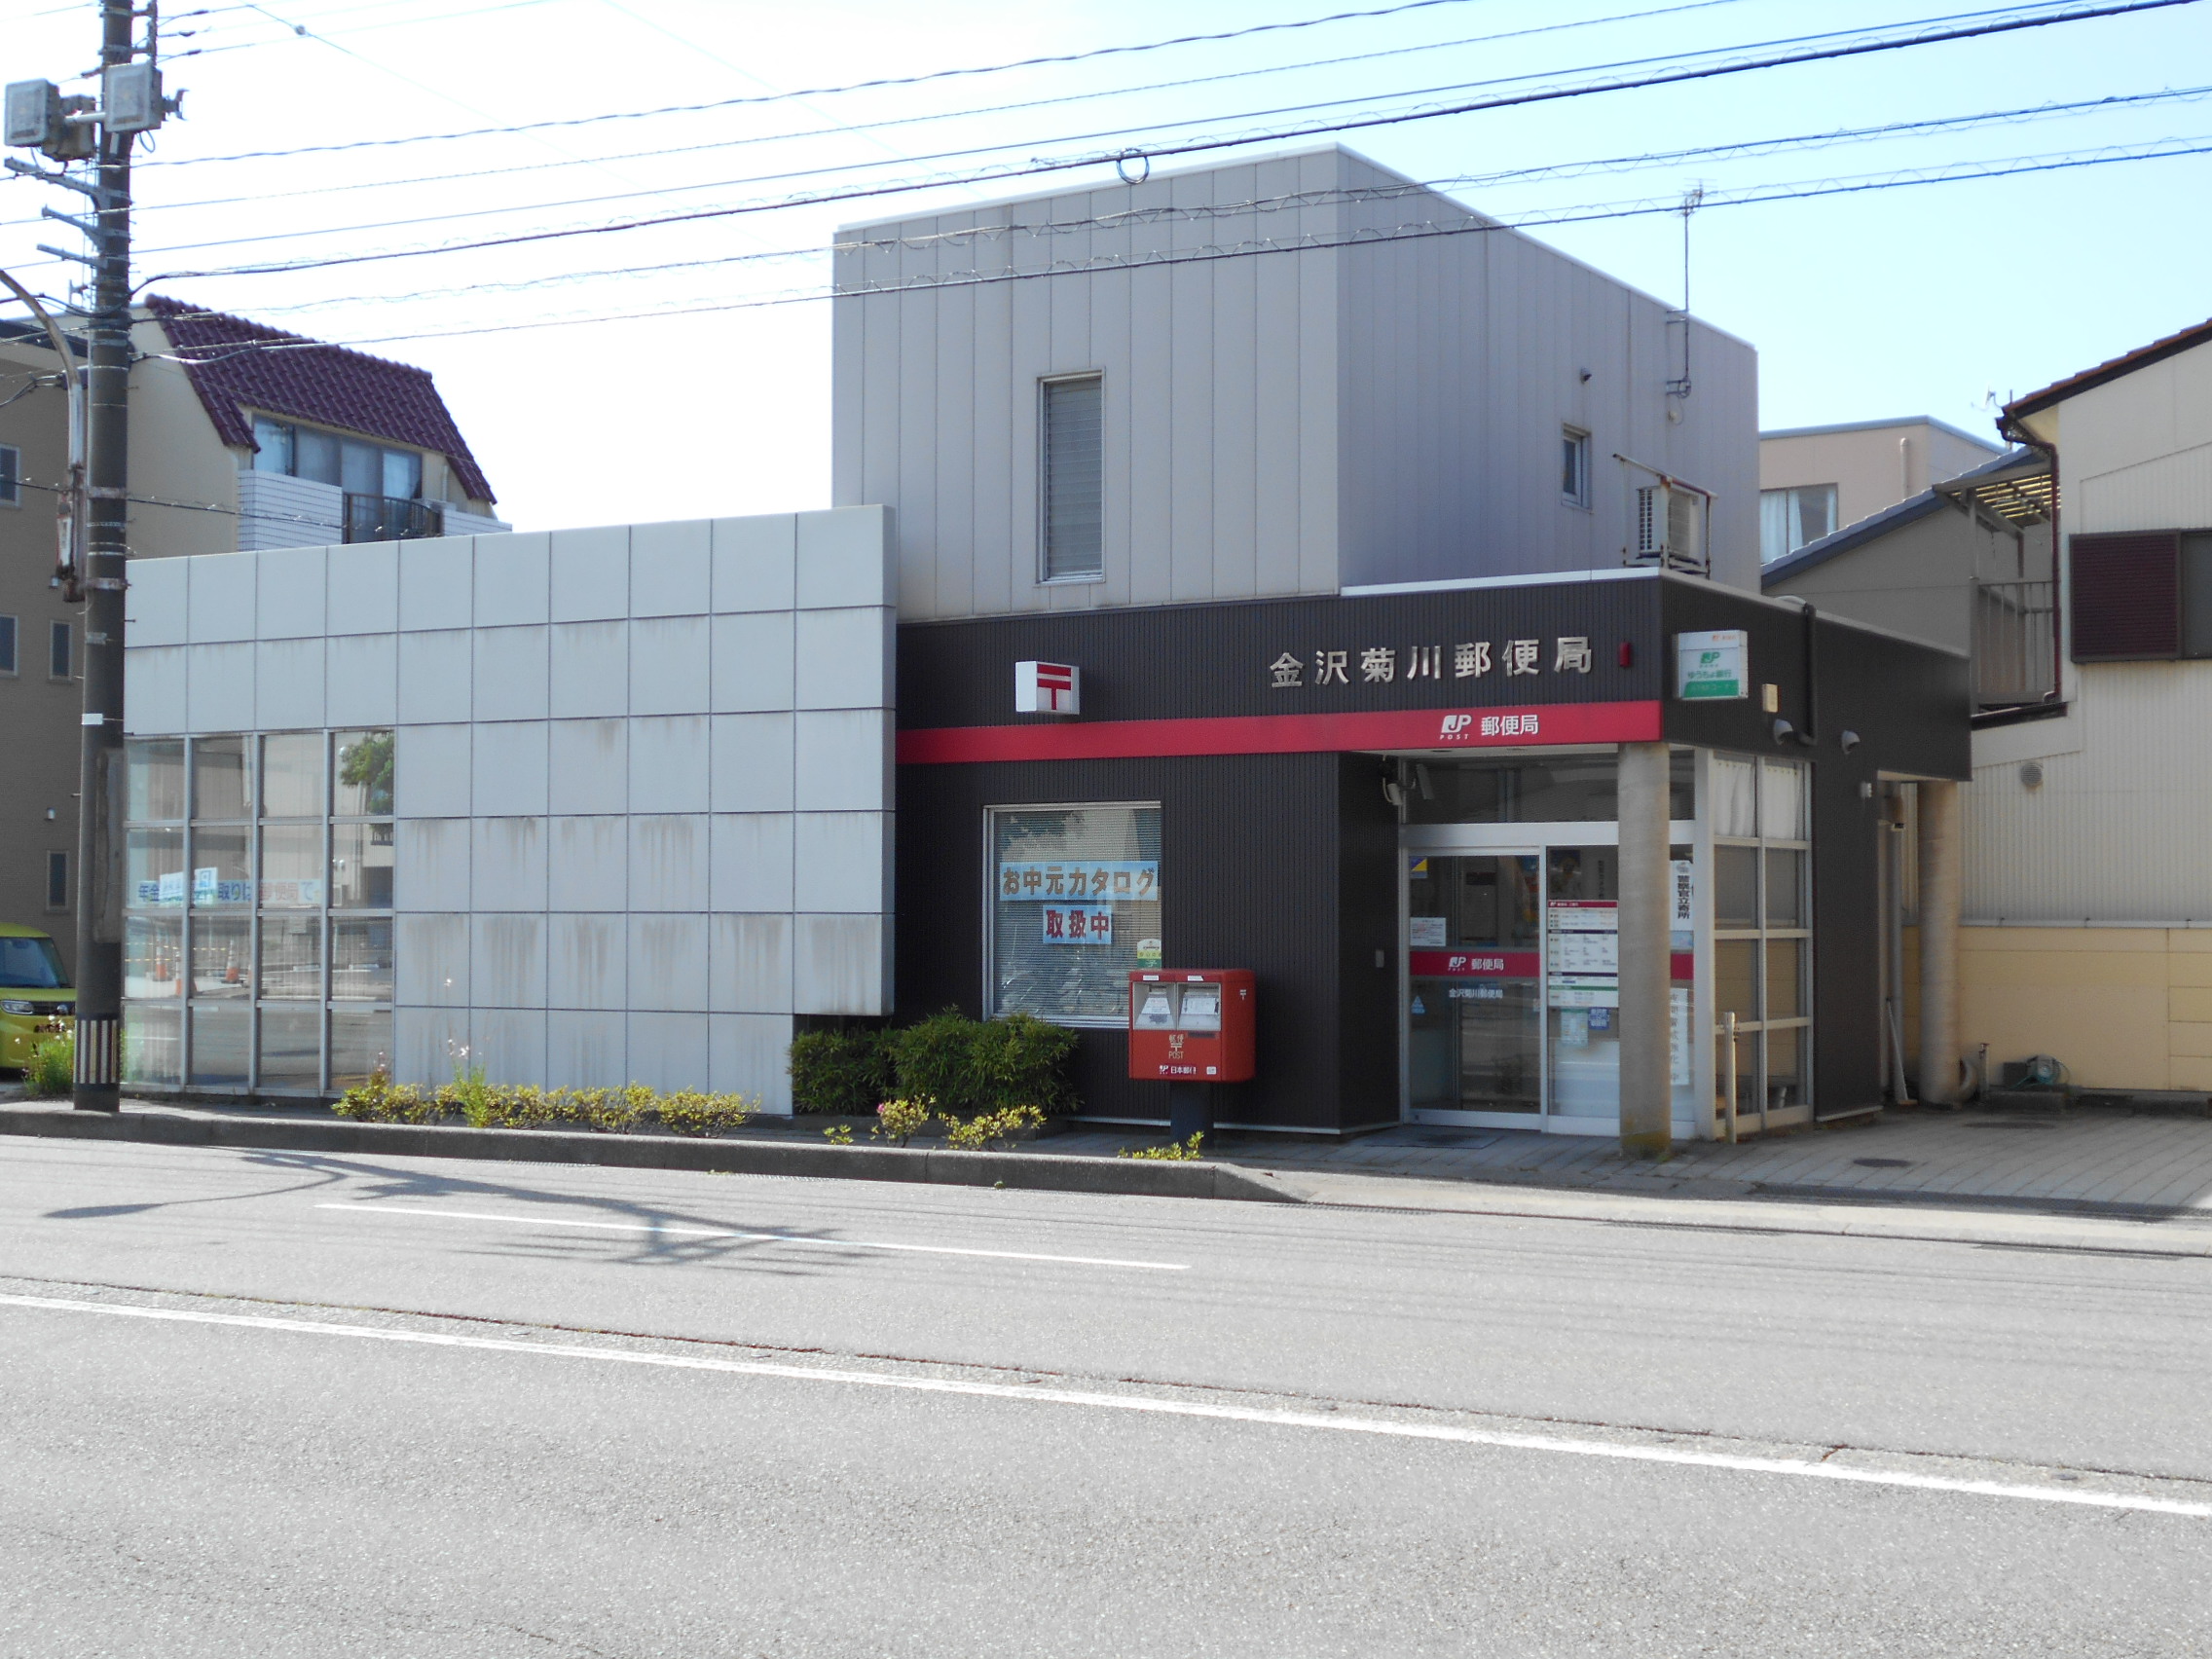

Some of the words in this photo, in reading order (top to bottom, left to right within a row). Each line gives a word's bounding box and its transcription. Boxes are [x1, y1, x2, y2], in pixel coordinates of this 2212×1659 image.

[1270, 636, 1593, 688] 金沢菊川郵便局
[1481, 714, 1539, 736] 郵便局
[1003, 866, 1156, 897] お中元カタログ
[1677, 875, 1690, 920] 警察官立寄所
[1046, 909, 1110, 940] 取扱中
[1471, 958, 1505, 971] 郵便局
